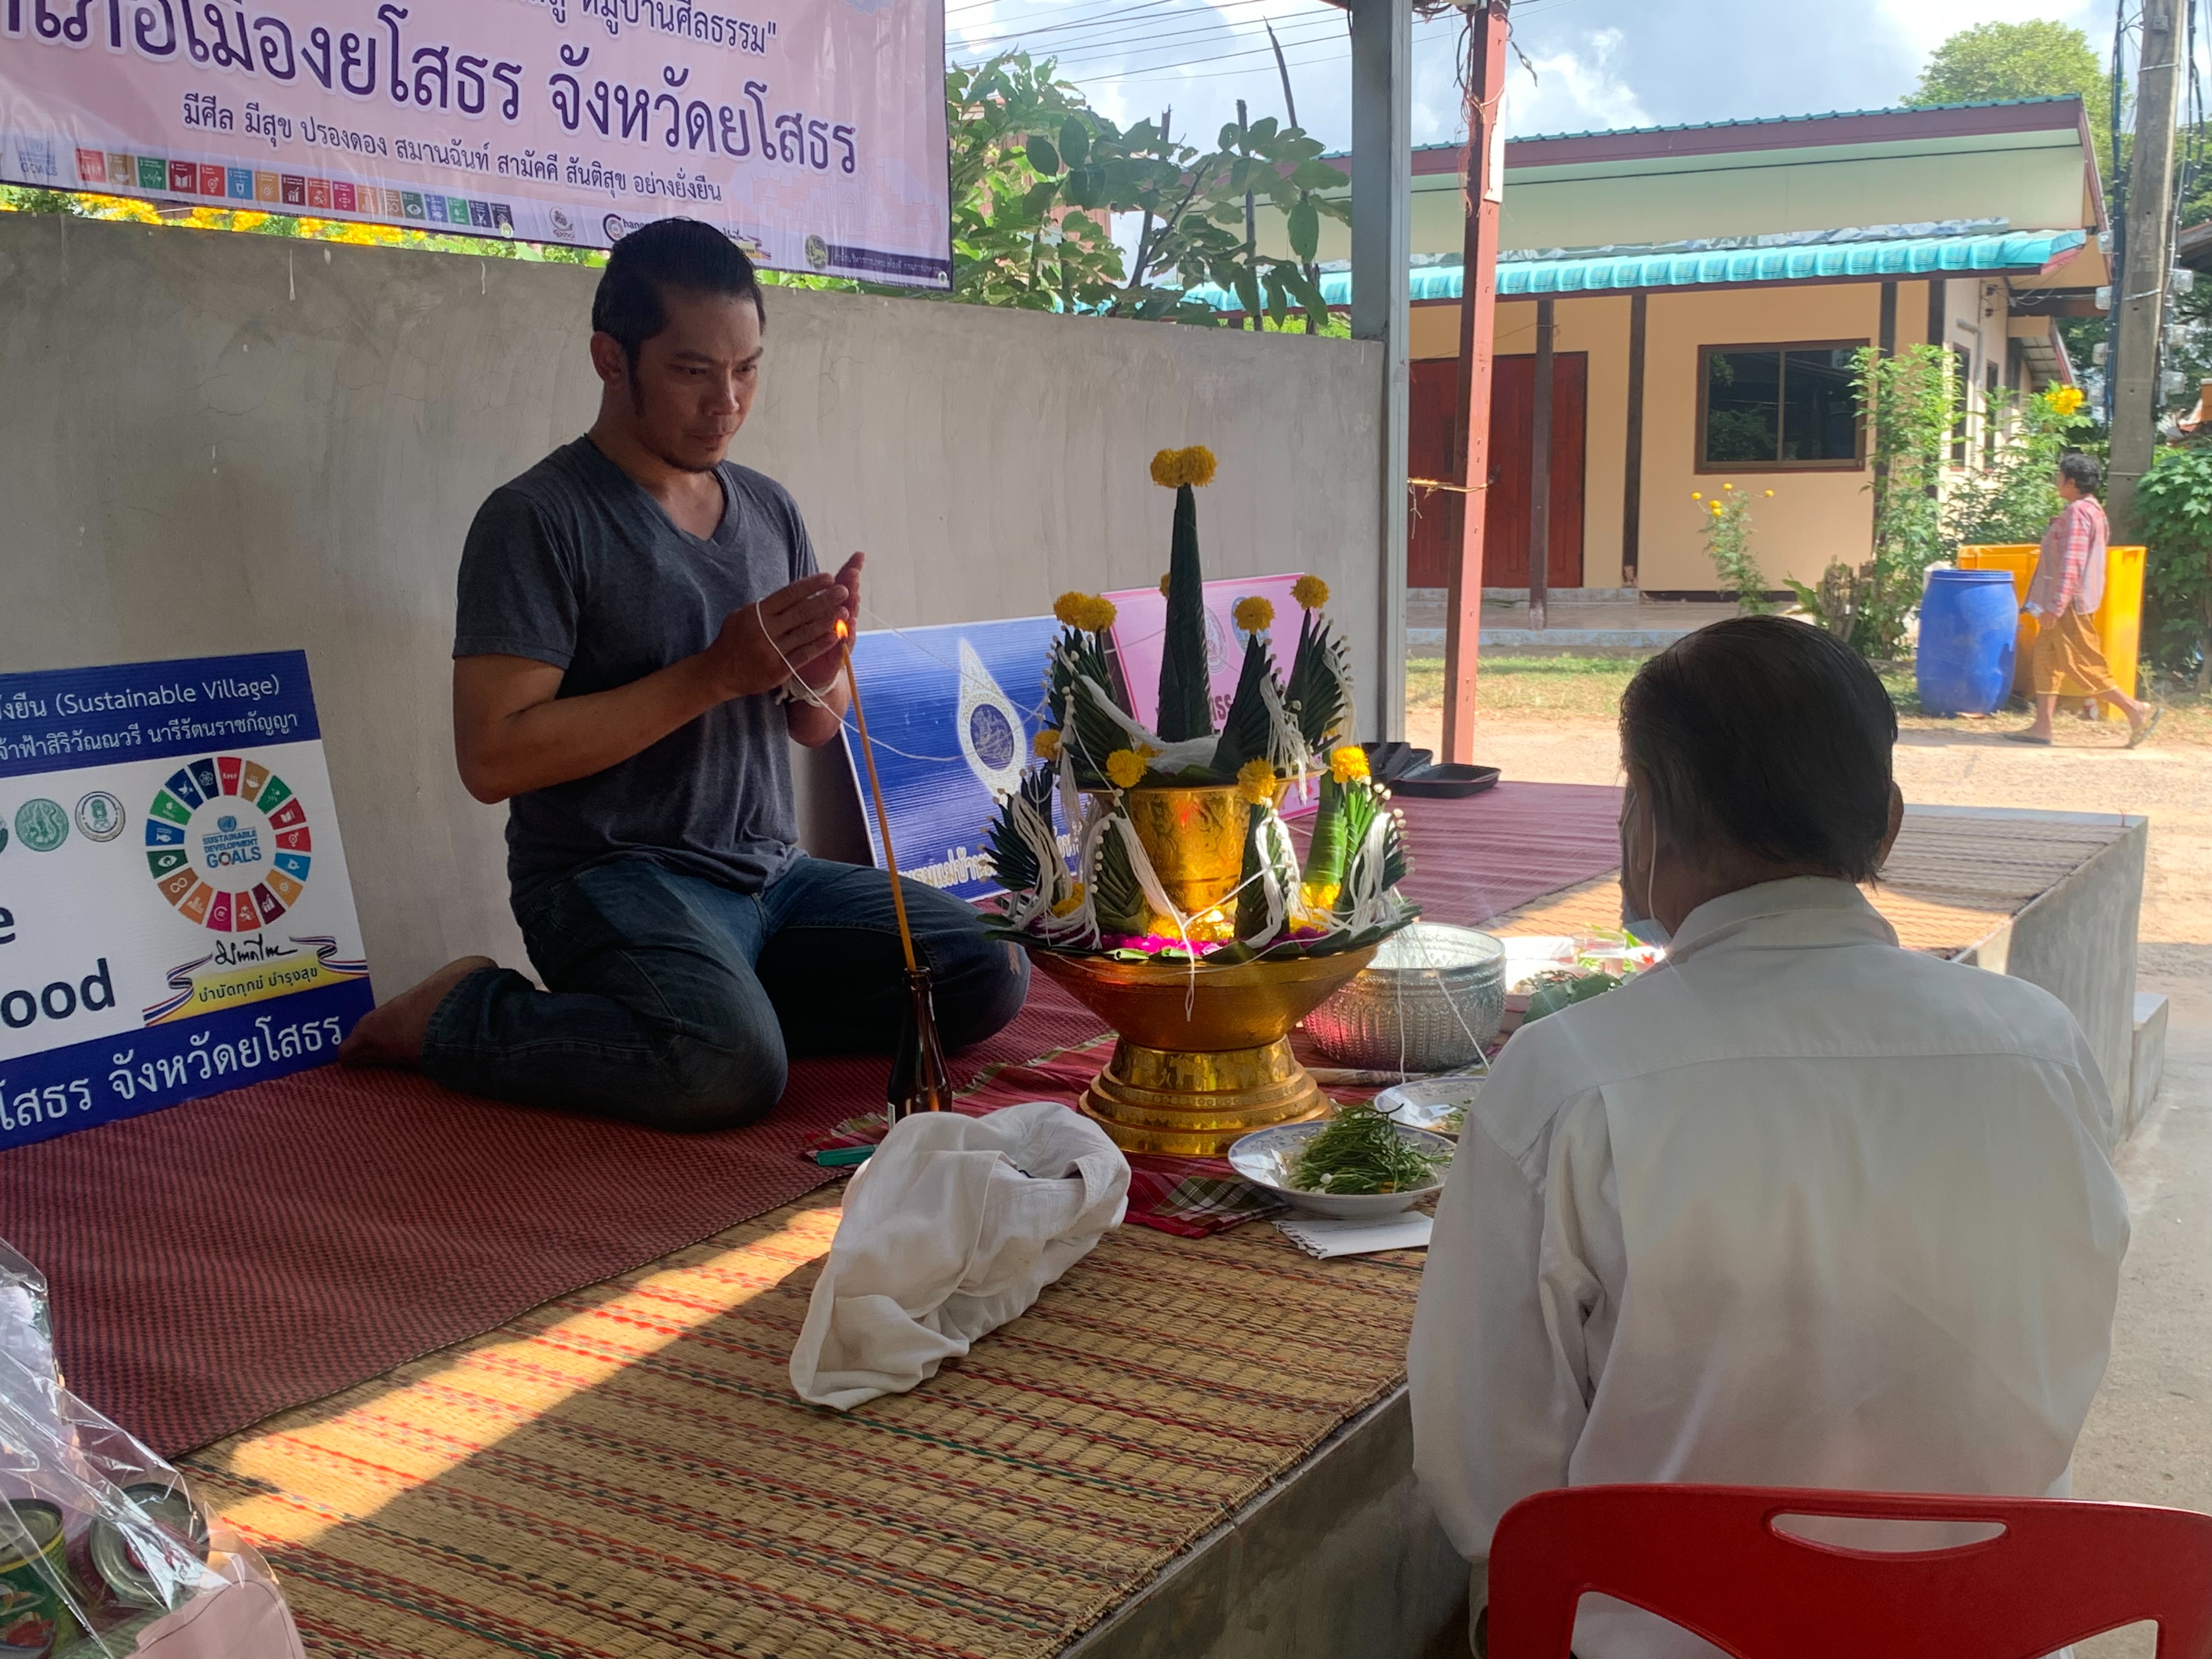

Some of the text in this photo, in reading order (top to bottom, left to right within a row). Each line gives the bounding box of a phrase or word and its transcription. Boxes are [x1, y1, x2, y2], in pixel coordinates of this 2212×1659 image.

[549, 44, 857, 174] จังหวัดยโสธร
[184, 93, 722, 201] มีศีล มีสุข ปรองดอง สมานฉันท์ สามัคคี สันติสุข อย่างยั่งยืน
[0, 674, 280, 720] งยืน (Sustainable Village)
[147, 710, 298, 743] นารีรัตนราชกัญญา
[202, 830, 257, 845] SUSTAINABLE
[204, 838, 257, 854] DEVELOPMENT
[206, 846, 262, 868] GOALS
[199, 967, 318, 1003] บำบัดทุกข์ บำรุงสุข
[108, 1015, 342, 1101] จังหวัดยโสธร
